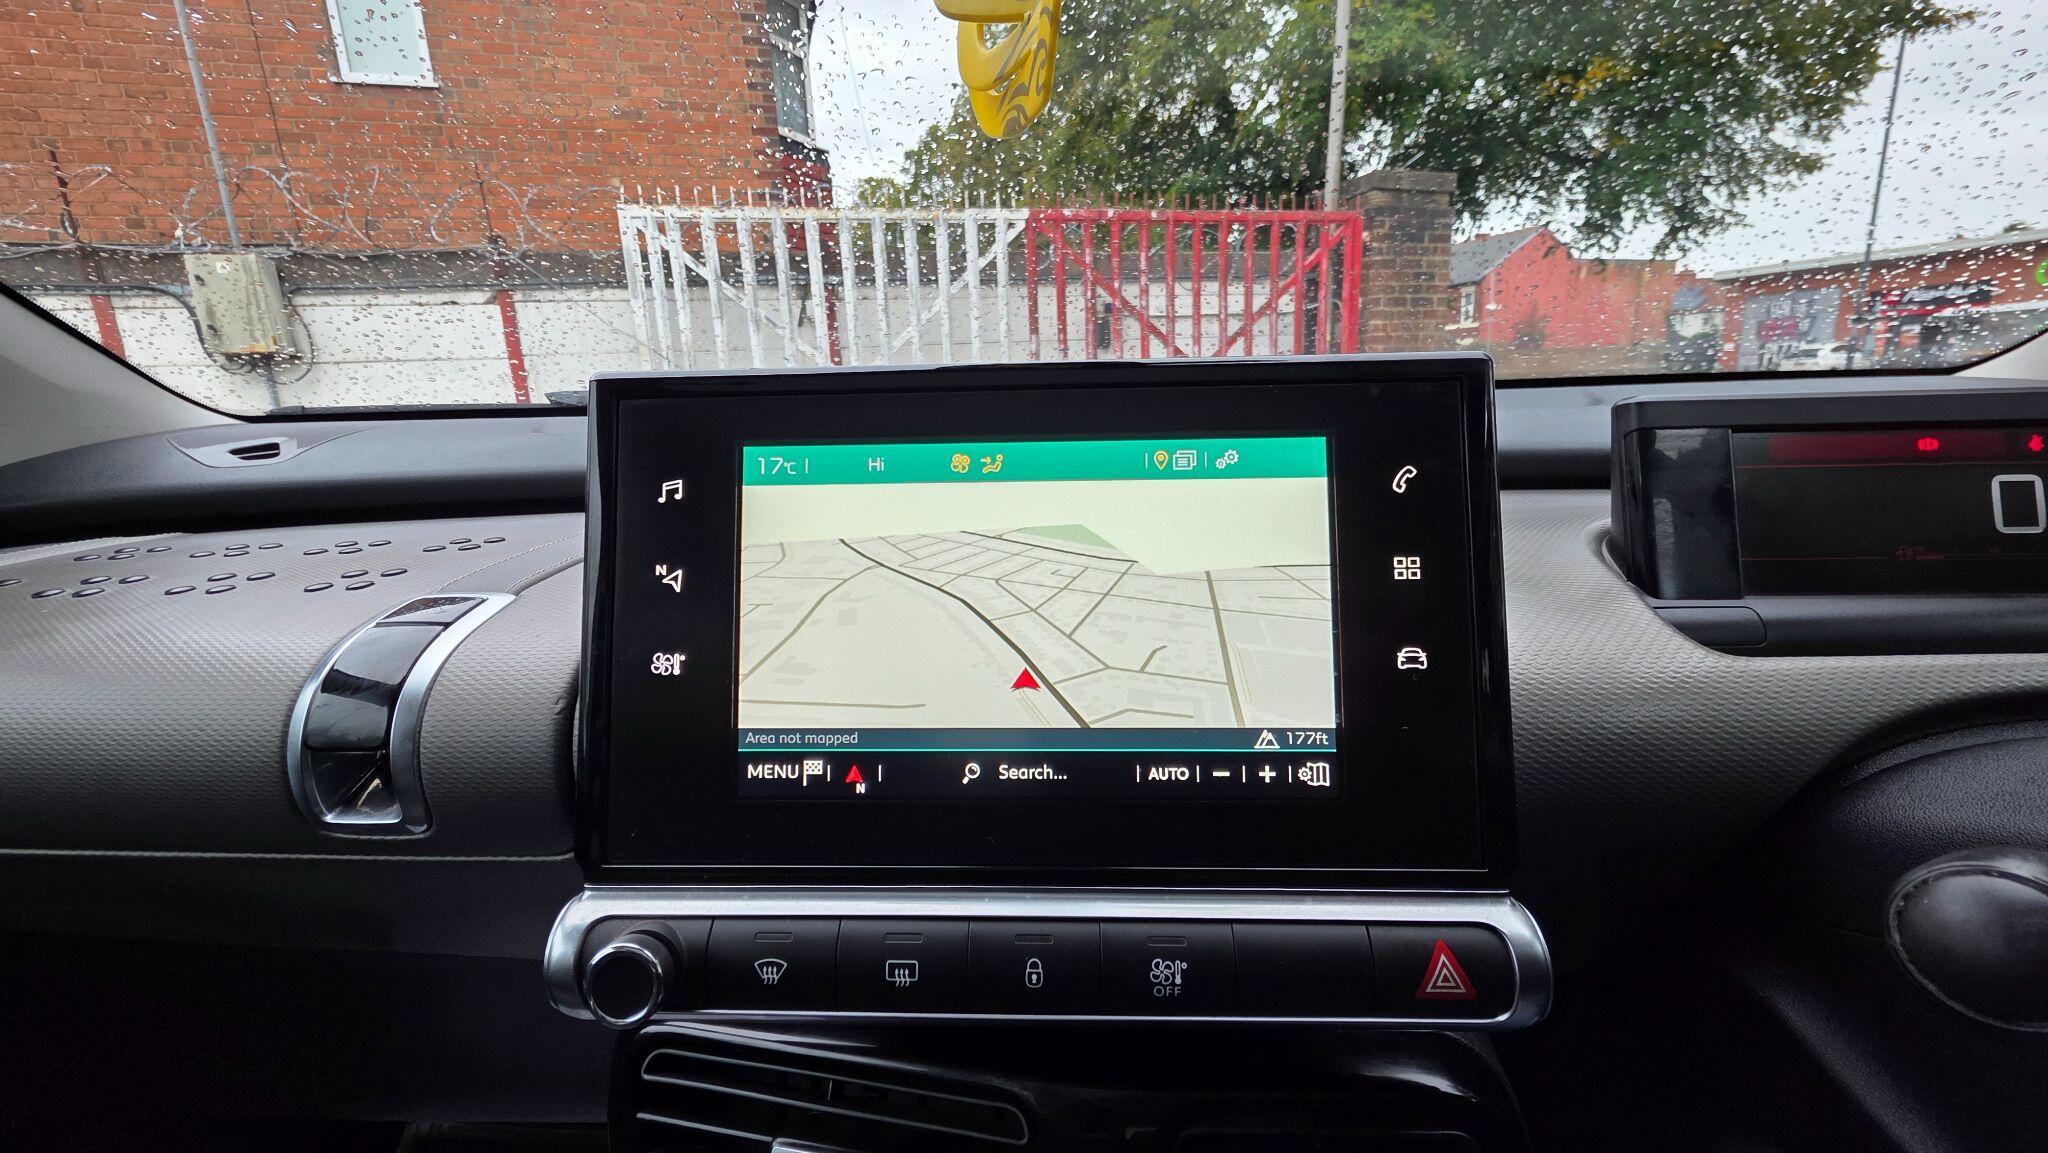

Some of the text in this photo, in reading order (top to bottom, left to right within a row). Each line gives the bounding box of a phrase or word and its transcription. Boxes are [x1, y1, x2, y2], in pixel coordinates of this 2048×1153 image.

[868, 457, 885, 472] Hi
[656, 564, 667, 576] N
[745, 732, 858, 747] Area not mapped
[1286, 731, 1329, 745] 177ft
[747, 764, 799, 779] MENU
[998, 763, 1068, 780] Search...
[1148, 767, 1190, 781] AUTO
[855, 782, 866, 794] N
[1153, 985, 1182, 998] OFF
